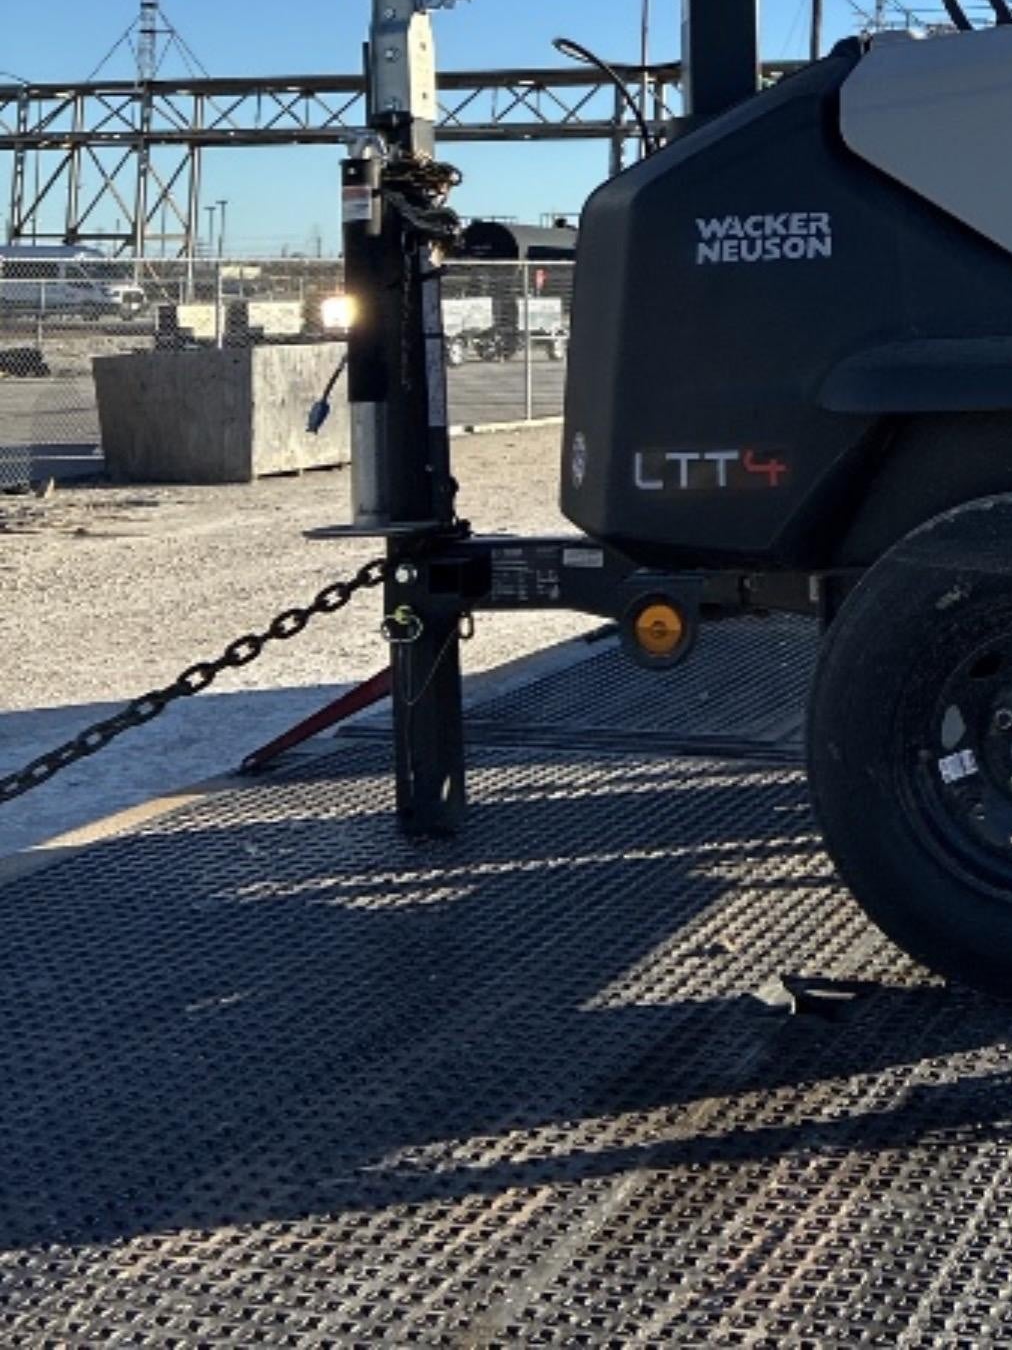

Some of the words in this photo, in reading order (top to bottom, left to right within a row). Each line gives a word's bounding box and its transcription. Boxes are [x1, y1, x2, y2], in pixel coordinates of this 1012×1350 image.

[695, 212, 832, 239] WACKER
[696, 237, 832, 264] NEUSON
[635, 450, 787, 489] LTT4
